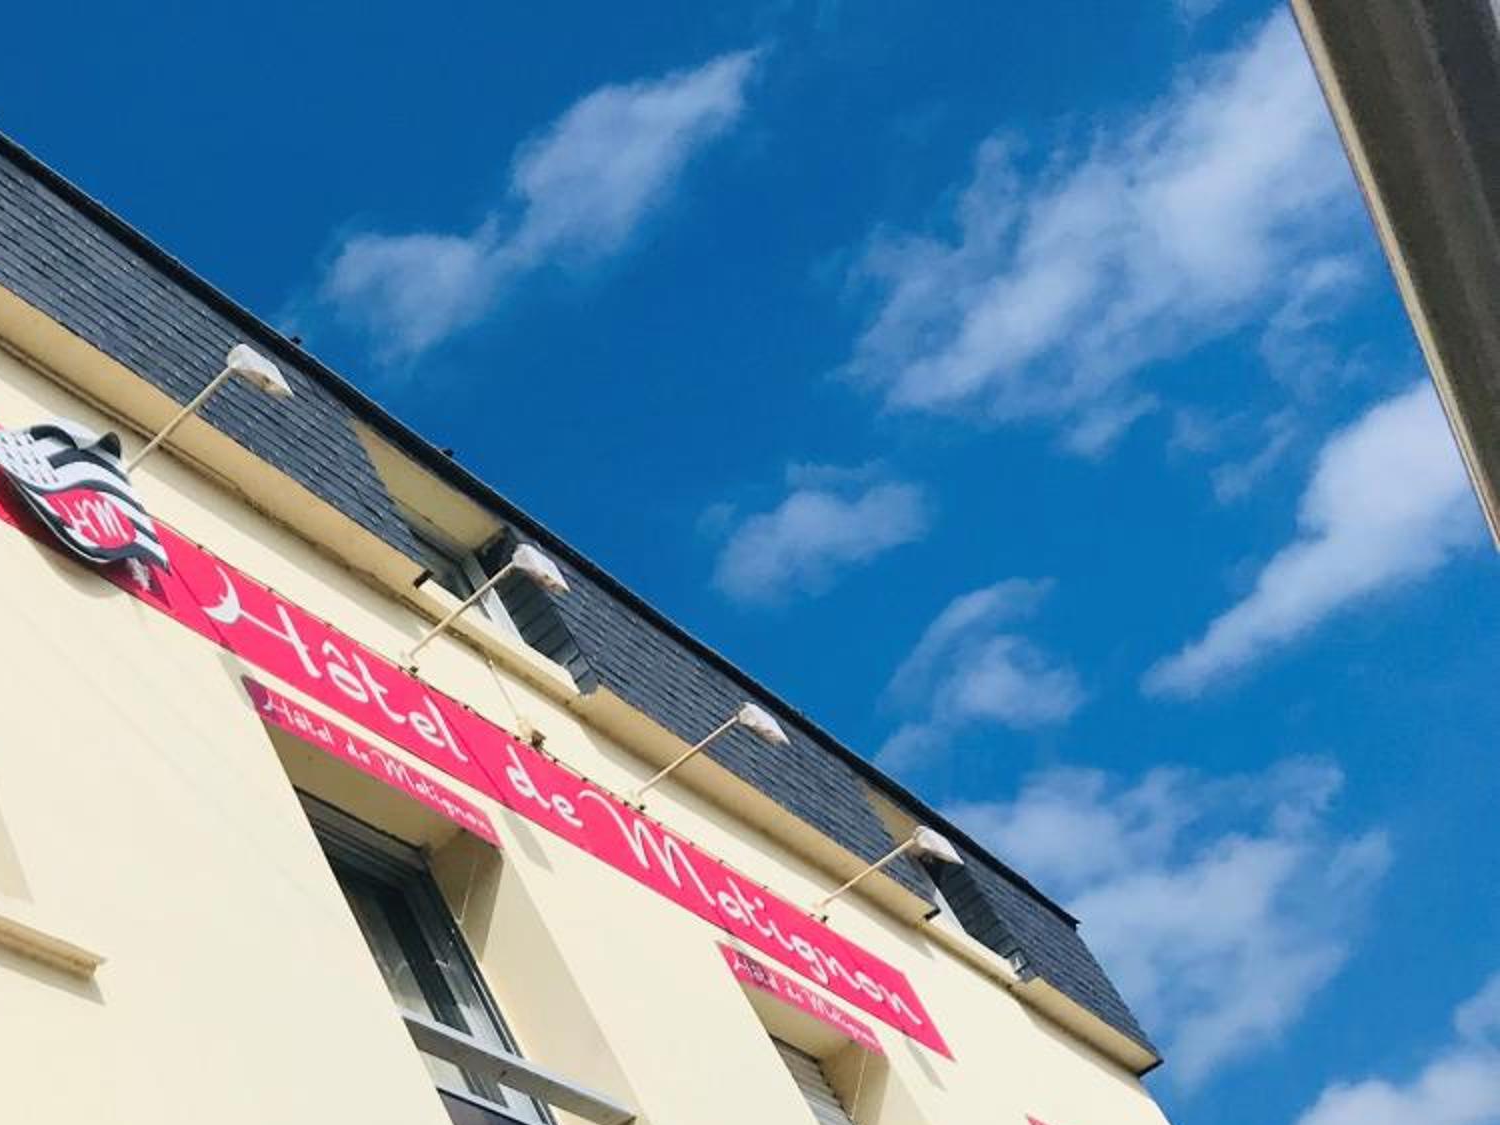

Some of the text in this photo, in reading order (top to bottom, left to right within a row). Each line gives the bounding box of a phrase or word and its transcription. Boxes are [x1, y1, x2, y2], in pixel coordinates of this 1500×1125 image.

[201, 566, 923, 1026] Hôtel de Matignon
